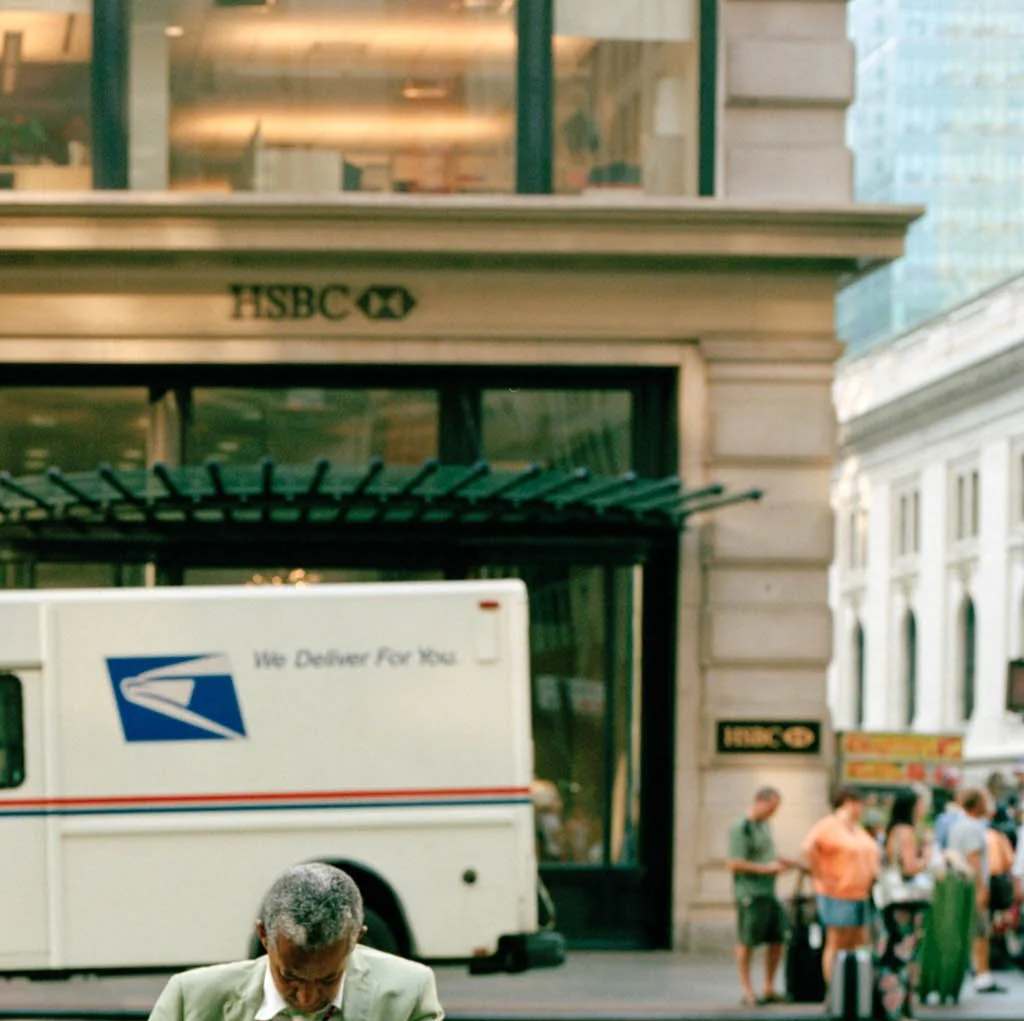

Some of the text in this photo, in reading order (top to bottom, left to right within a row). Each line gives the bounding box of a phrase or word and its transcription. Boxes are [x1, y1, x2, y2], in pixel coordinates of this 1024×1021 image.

[229, 284, 350, 320] HSBC
[253, 649, 286, 669] We
[293, 648, 369, 668] Deliver
[374, 646, 410, 666] For
